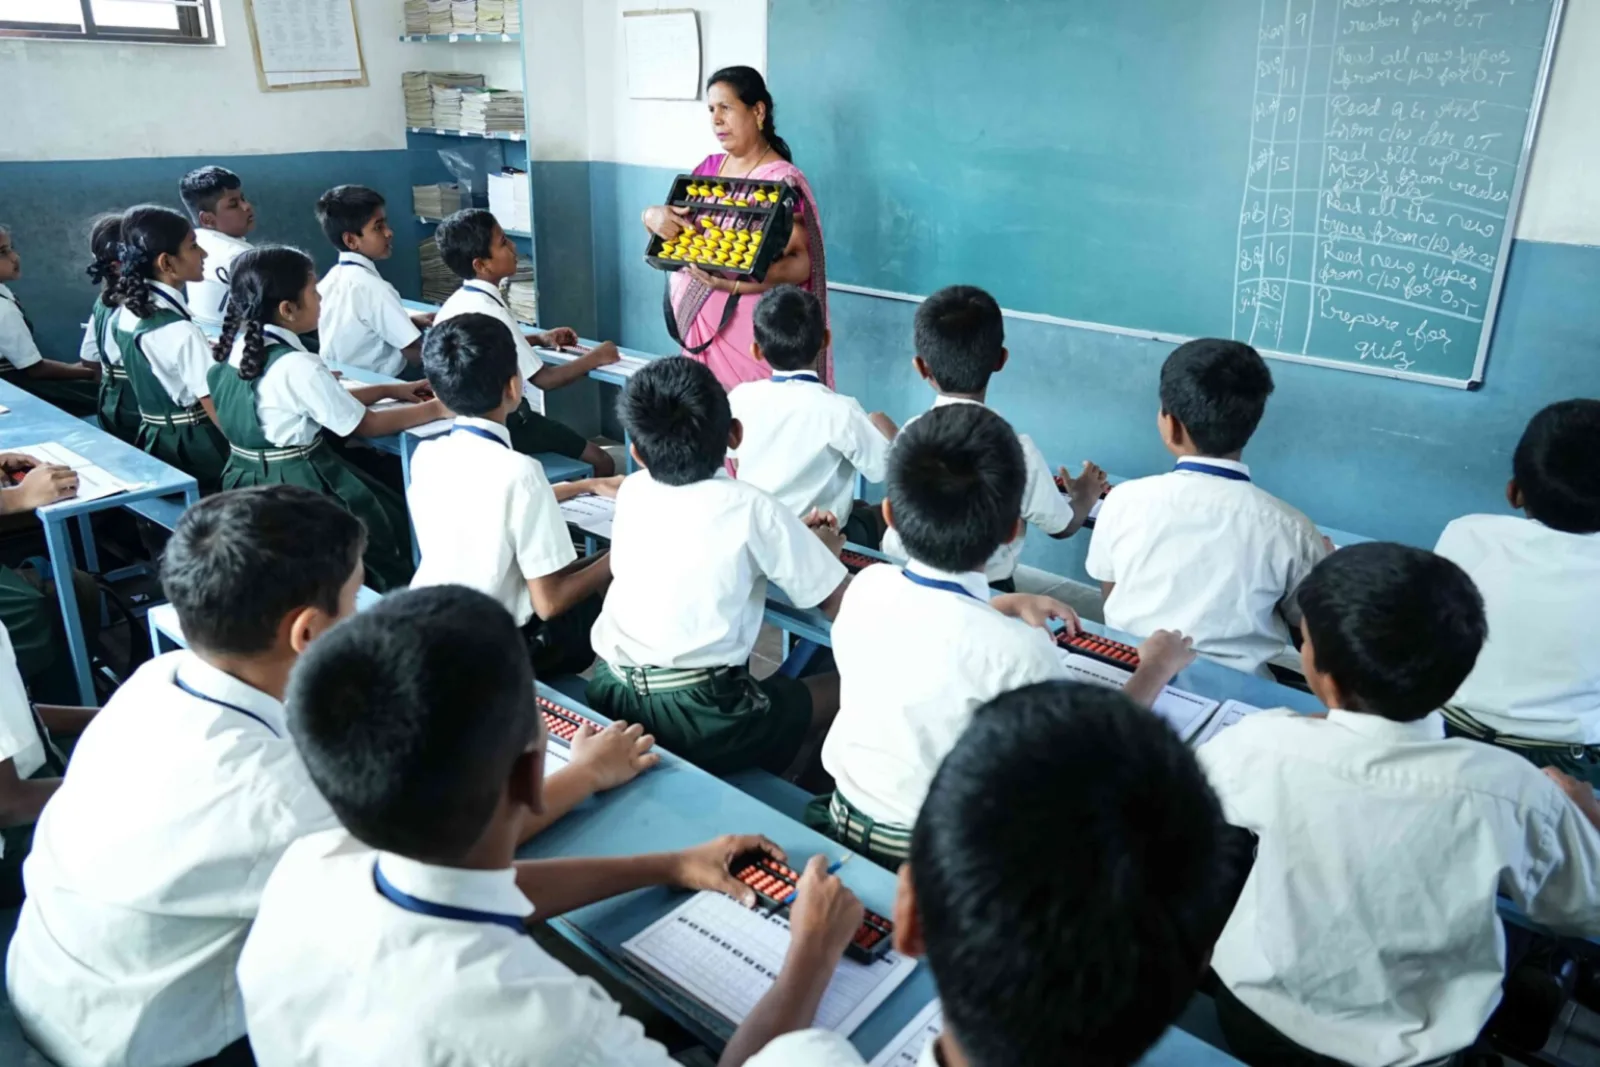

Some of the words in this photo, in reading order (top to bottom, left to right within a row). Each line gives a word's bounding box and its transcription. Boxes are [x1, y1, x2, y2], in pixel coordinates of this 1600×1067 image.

[1295, 12, 1307, 37] 9
[1336, 46, 1374, 65] Read
[1380, 46, 1409, 65] all
[1416, 51, 1453, 64] new
[1331, 95, 1381, 117] Read
[1325, 117, 1373, 140] from
[1418, 120, 1454, 146] for
[1273, 156, 1290, 176] 15
[1328, 142, 1369, 162] Read
[1396, 167, 1444, 186] from
[1449, 181, 1509, 202] reader
[1272, 203, 1292, 228] 13
[1322, 190, 1363, 214] Read
[1368, 197, 1398, 219] all
[1403, 203, 1440, 225] the
[1446, 213, 1495, 238] new
[1320, 213, 1366, 242] types
[1370, 220, 1418, 245] from
[1269, 241, 1286, 266] 16
[1321, 240, 1364, 267] Read
[1371, 253, 1415, 273] new
[1422, 262, 1477, 290] types
[1319, 263, 1364, 284] from
[1403, 275, 1432, 300] for
[1317, 286, 1400, 333] Prepare
[1406, 319, 1452, 355] for
[1354, 340, 1416, 371] quiz
